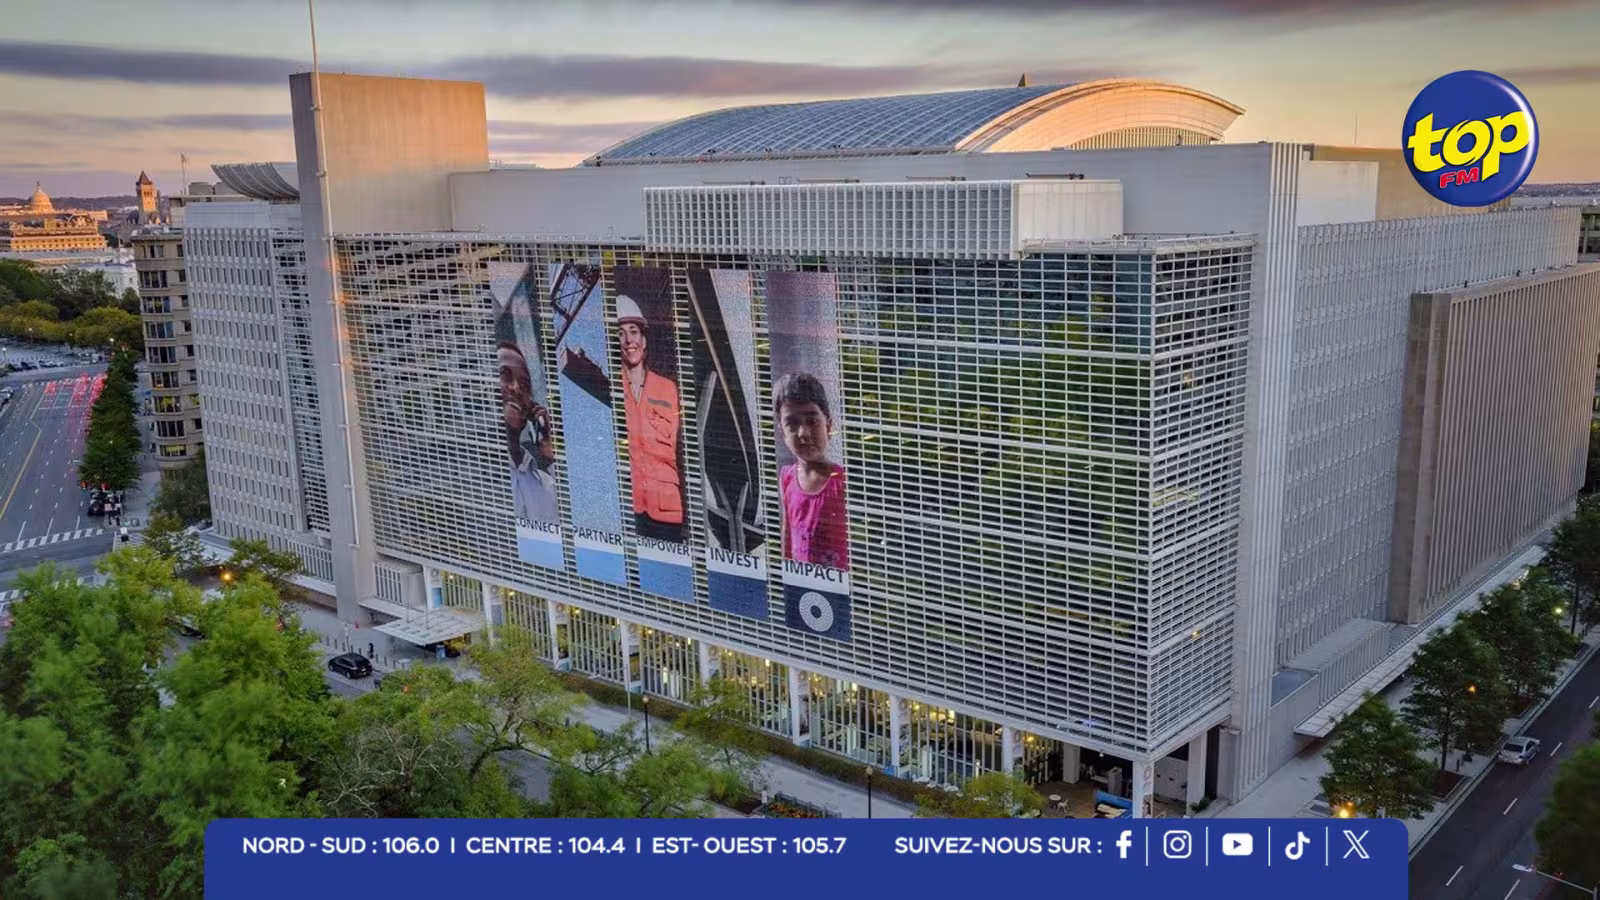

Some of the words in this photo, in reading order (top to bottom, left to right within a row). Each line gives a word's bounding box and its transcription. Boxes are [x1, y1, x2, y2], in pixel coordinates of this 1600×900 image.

[572, 525, 623, 546] PARTNER
[637, 536, 691, 556] EMPOWER
[710, 547, 760, 569] INVEST
[784, 560, 845, 583] IMPACT
